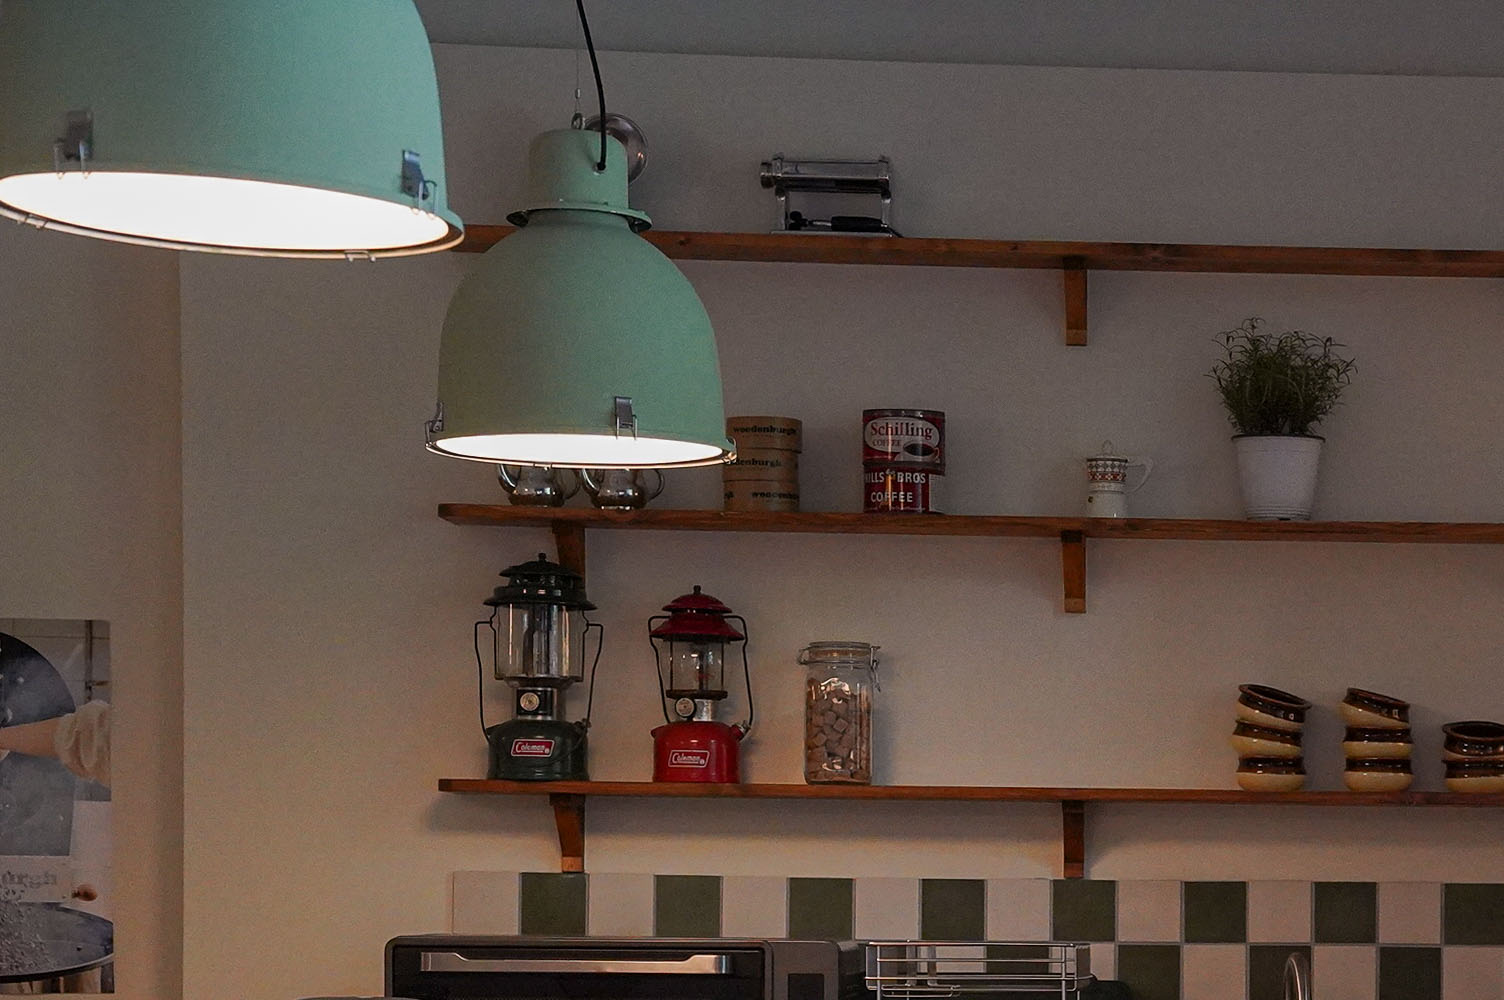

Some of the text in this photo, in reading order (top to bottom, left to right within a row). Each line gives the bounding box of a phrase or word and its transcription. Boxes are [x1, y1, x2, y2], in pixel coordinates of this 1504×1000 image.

[871, 422, 933, 440] Schilling
[896, 472, 927, 484] BROS
[870, 491, 913, 503] COFFEE
[515, 741, 546, 753] Coleman
[672, 752, 701, 764] Coleman
